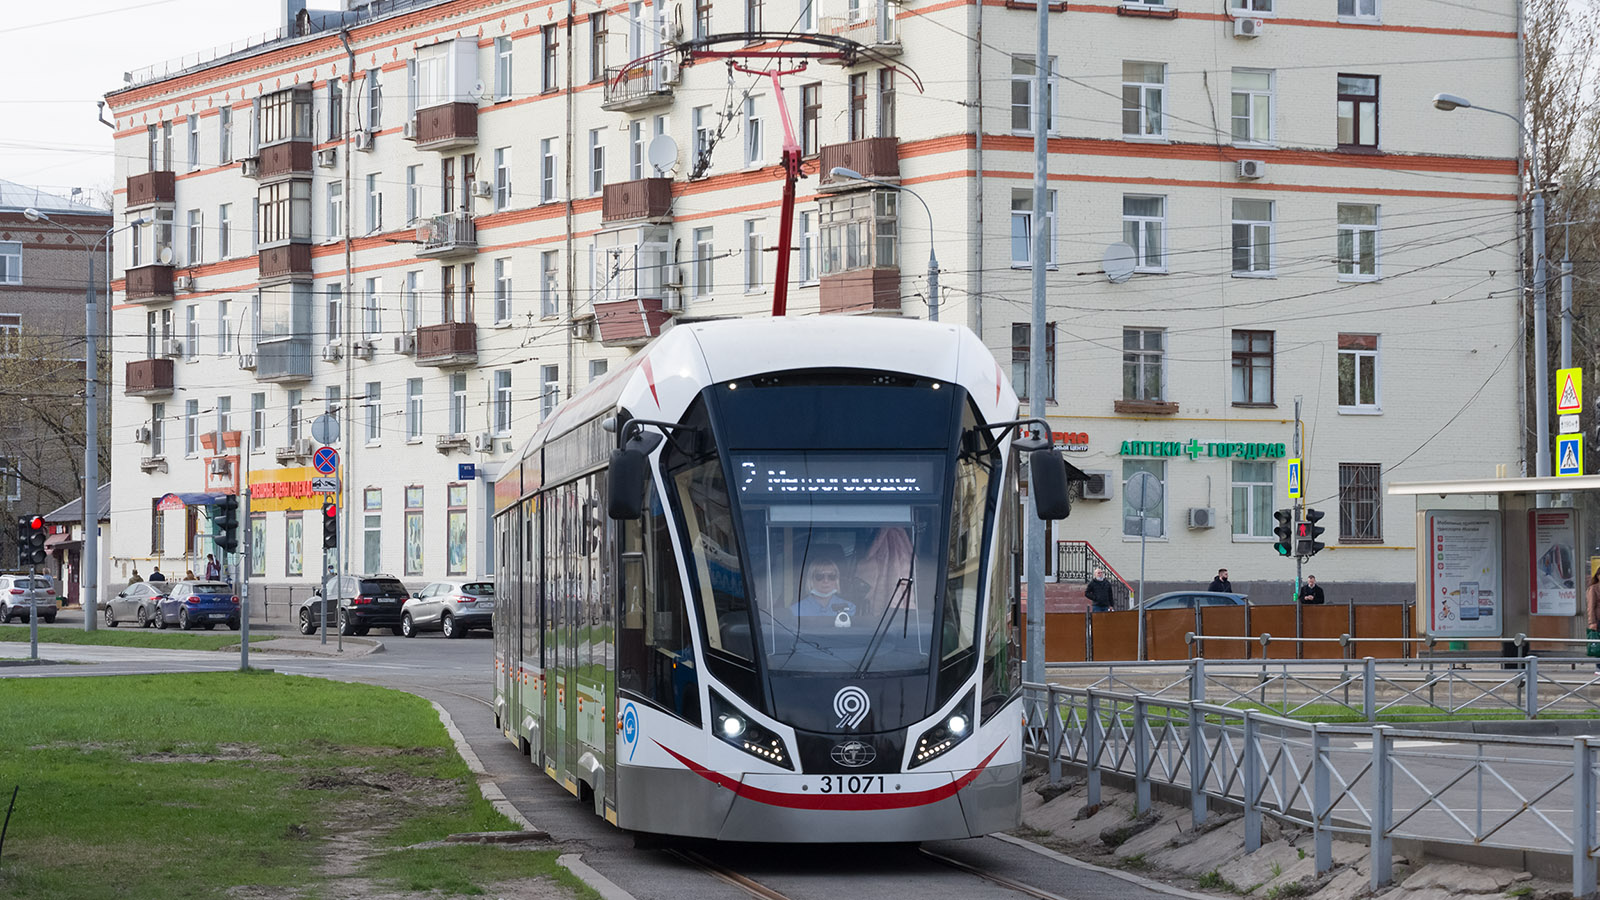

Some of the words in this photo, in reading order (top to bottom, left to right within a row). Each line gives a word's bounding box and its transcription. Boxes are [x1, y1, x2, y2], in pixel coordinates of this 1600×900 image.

[1120, 440, 1181, 457] АПТЕКИ
[1208, 442, 1286, 460] ГОРЗДРАВ
[820, 776, 884, 793] 31071
